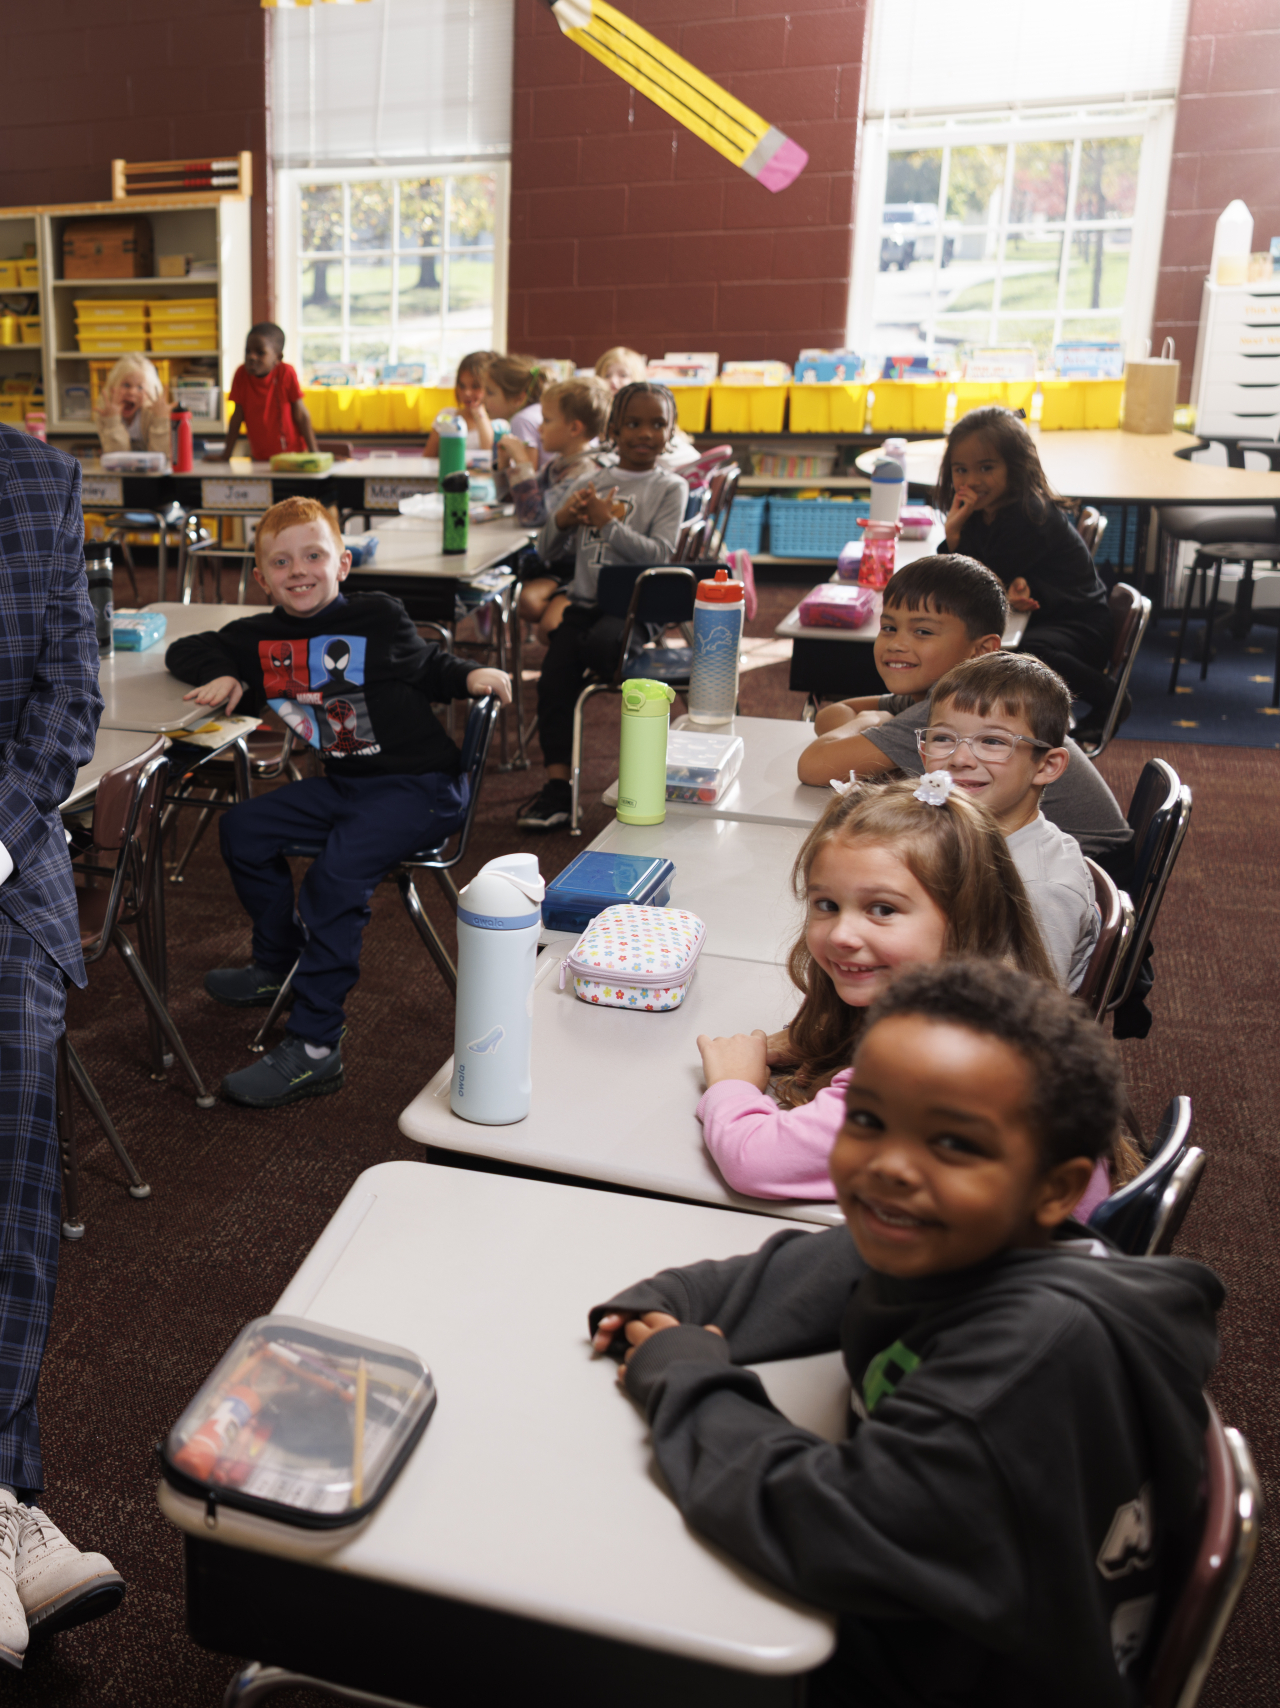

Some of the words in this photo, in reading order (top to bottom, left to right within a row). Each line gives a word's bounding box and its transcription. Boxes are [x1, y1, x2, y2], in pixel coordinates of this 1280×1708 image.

[225, 486, 249, 499] Joe
[296, 692, 322, 704] MARVEL
[472, 915, 505, 928] owala
